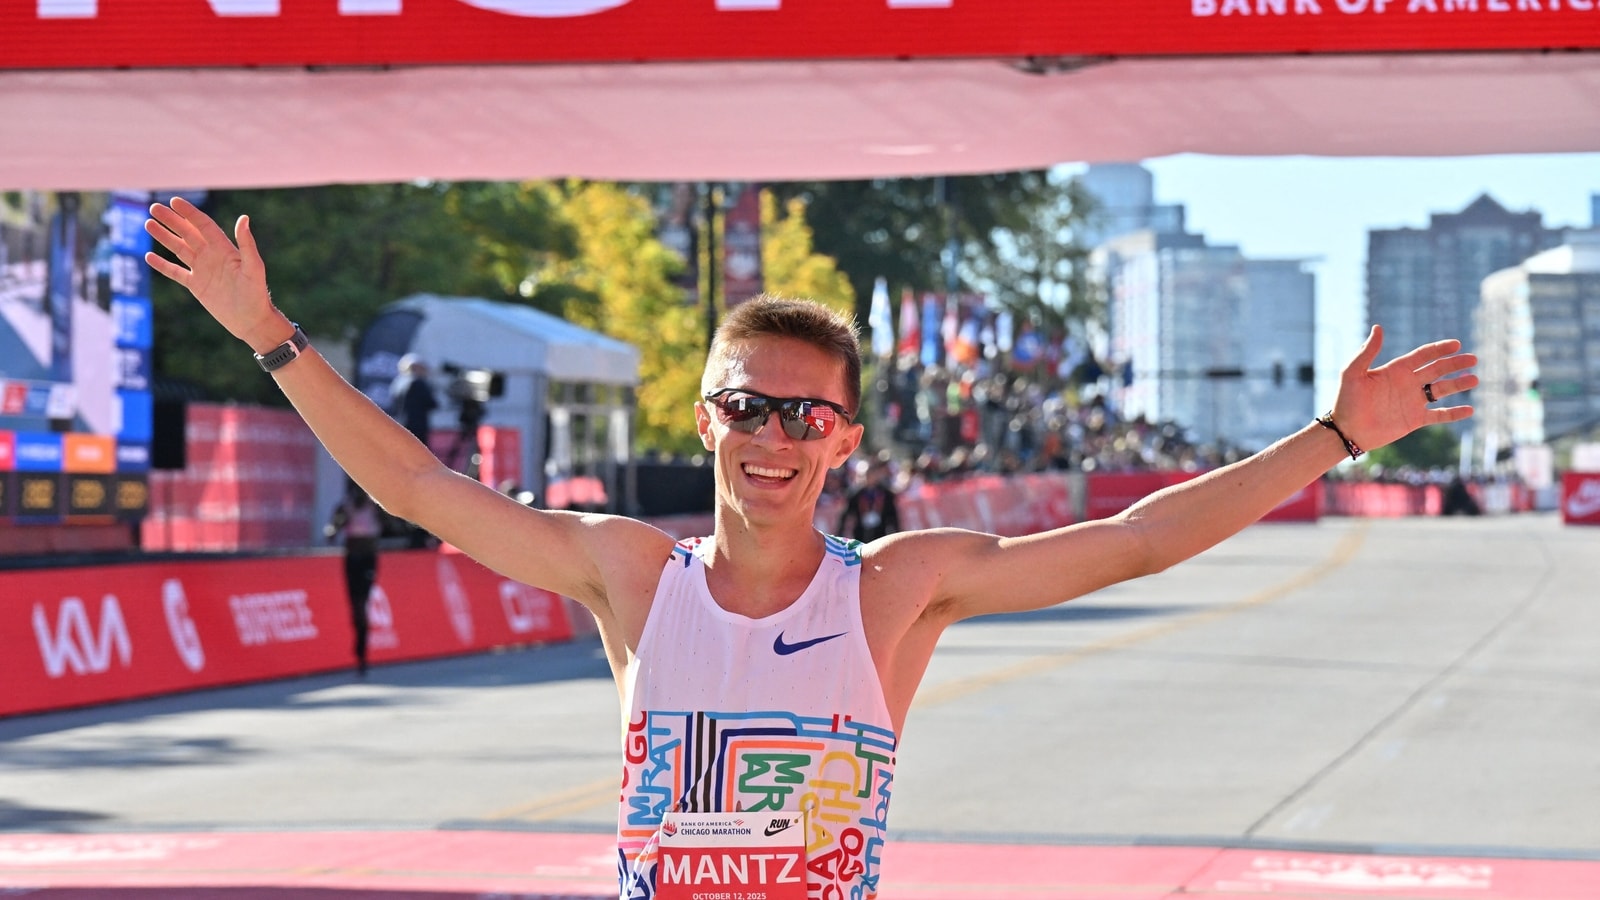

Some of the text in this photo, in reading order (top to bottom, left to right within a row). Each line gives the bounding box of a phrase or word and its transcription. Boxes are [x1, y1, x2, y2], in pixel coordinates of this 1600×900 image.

[770, 819, 791, 829] RUN
[681, 828, 752, 836] CHICAGO MARATHON
[662, 853, 801, 885] MANTZ
[692, 892, 767, 900] OCTOBER 12, 2025
